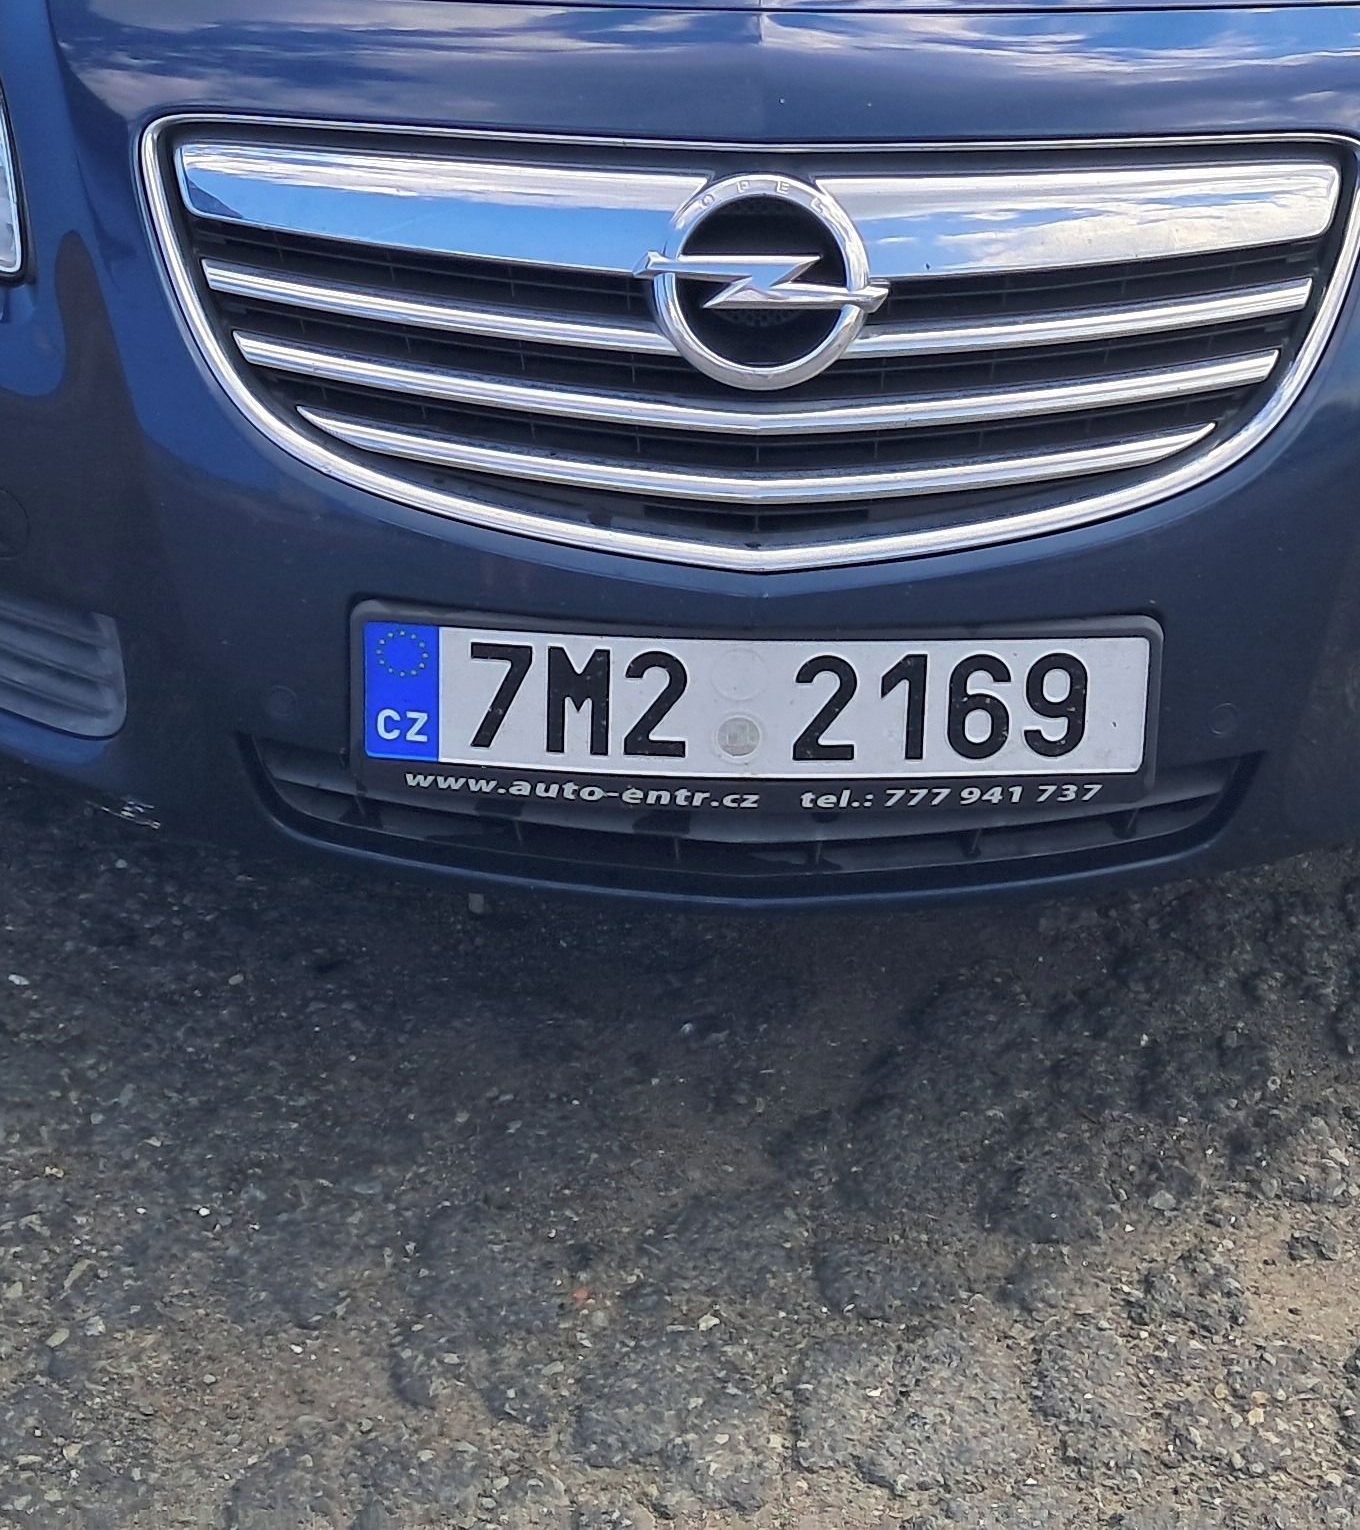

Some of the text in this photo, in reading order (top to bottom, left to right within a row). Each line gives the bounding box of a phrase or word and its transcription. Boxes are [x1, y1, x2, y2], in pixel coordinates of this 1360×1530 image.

[699, 180, 825, 213] OPEL
[469, 641, 1089, 762] 7M2 2169
[376, 706, 430, 743] CZ
[404, 772, 1104, 809] www.auto-entr.cz tel.: 777 941 737
